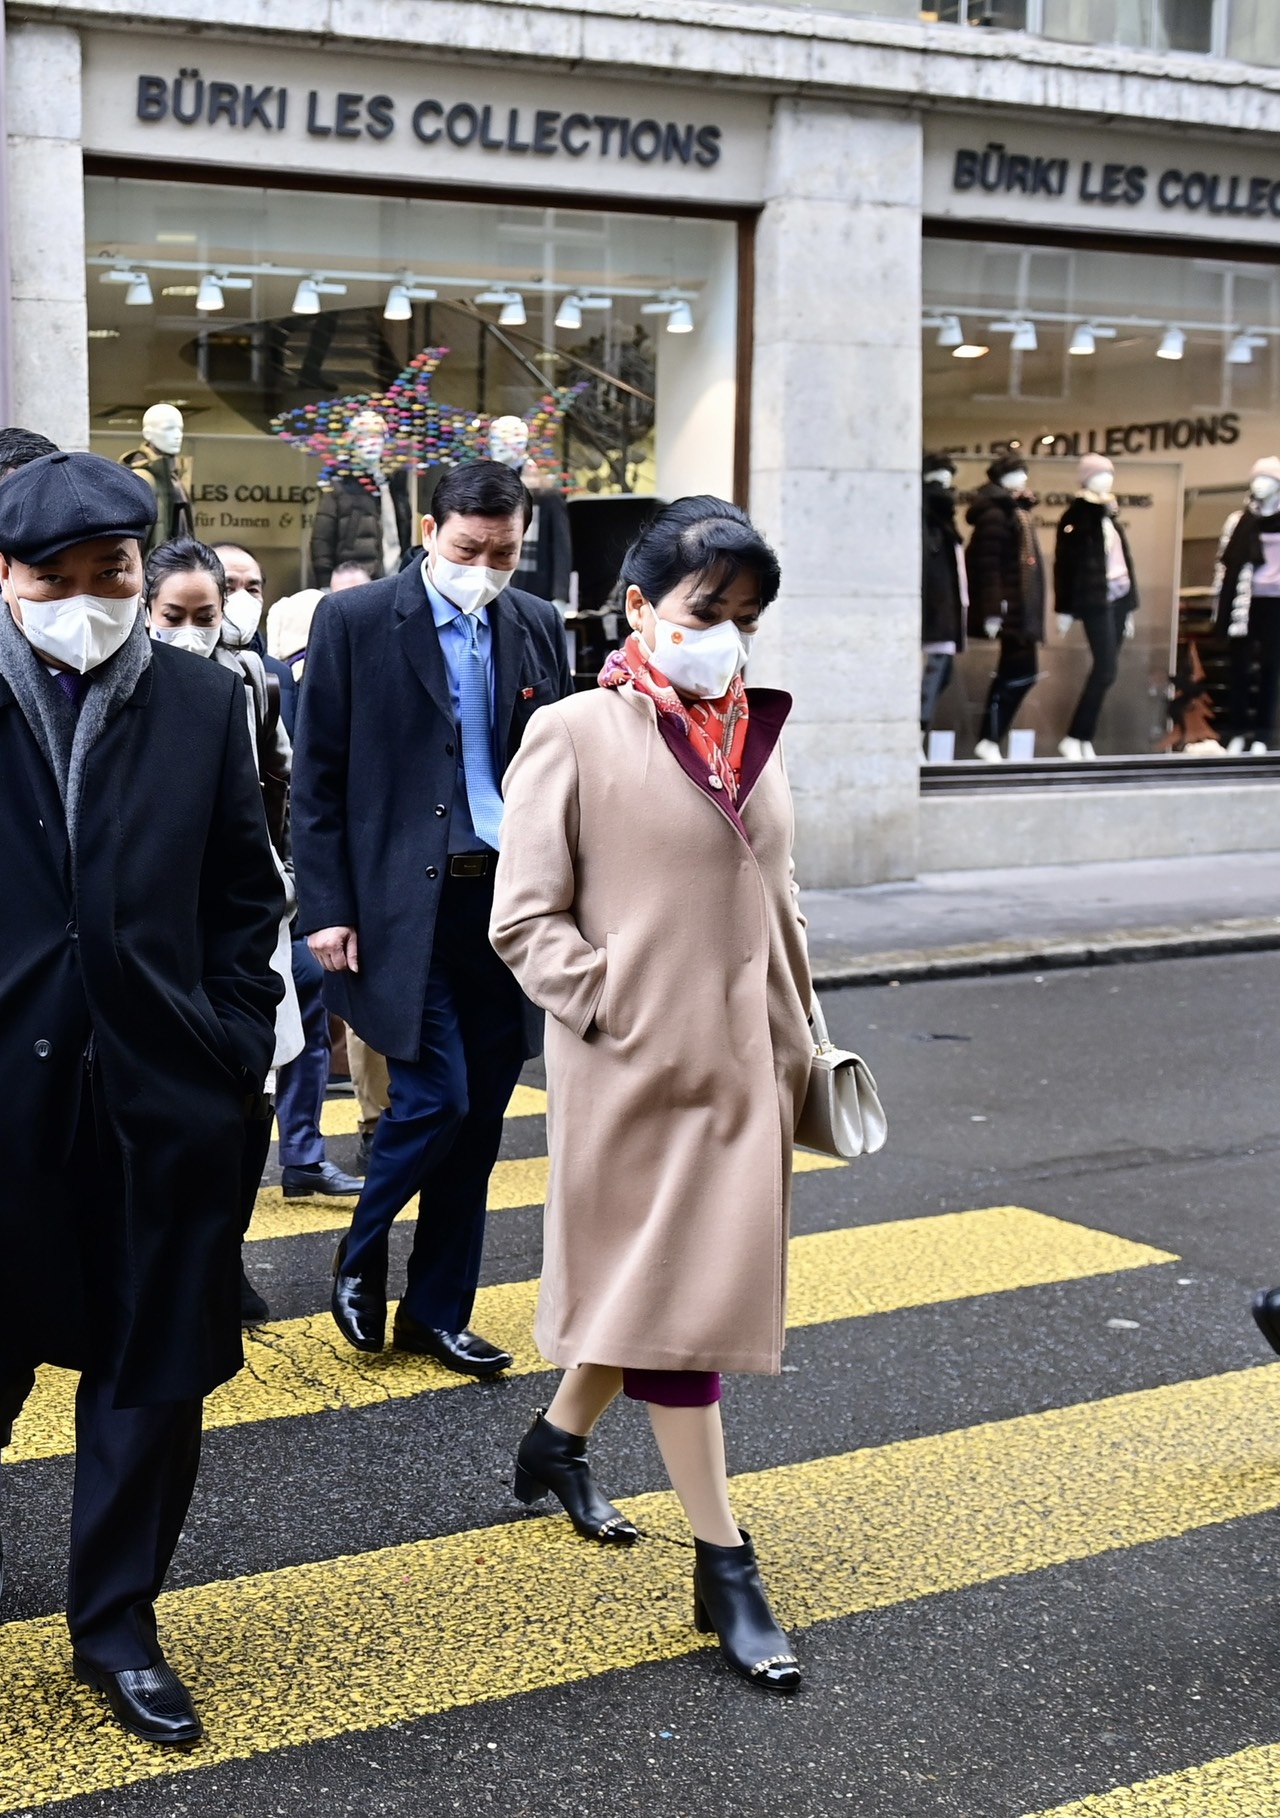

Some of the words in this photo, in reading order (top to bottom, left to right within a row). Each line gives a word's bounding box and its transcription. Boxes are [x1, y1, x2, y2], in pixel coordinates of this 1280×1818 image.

[136, 67, 287, 131] BÜRKI
[306, 89, 395, 140] LES
[411, 98, 722, 168] COLLECTIONS
[953, 141, 1069, 195] BÜRKI
[1078, 160, 1148, 205] LES
[191, 484, 228, 503] LES
[234, 485, 324, 505] COLLEC
[195, 511, 216, 528] für
[220, 512, 270, 529] Damen
[278, 512, 293, 529] &
